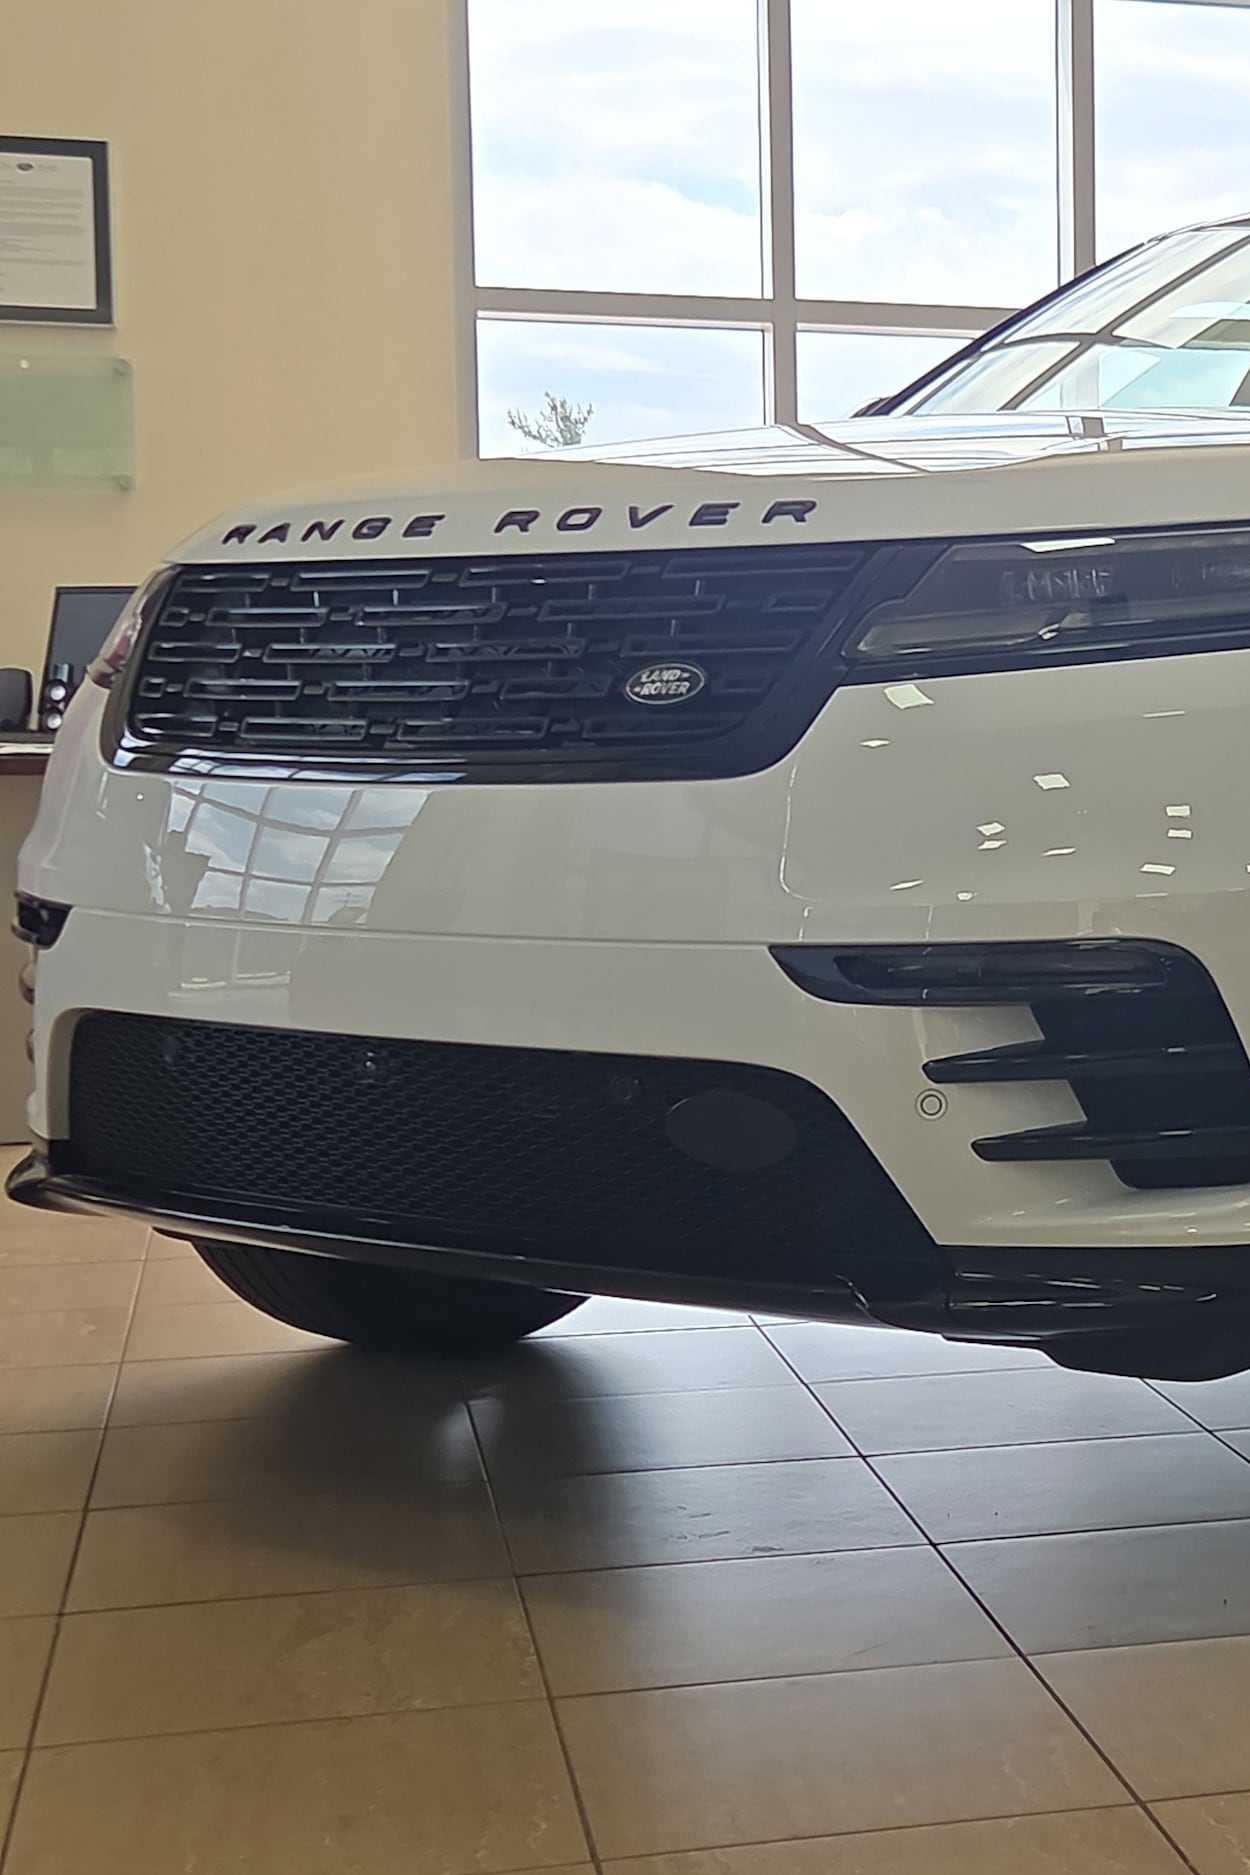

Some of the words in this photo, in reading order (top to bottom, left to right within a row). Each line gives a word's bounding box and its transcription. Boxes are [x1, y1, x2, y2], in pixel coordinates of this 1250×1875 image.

[222, 514, 445, 545] RANGE
[494, 499, 819, 534] ROVER
[640, 681, 690, 696] ROVER
